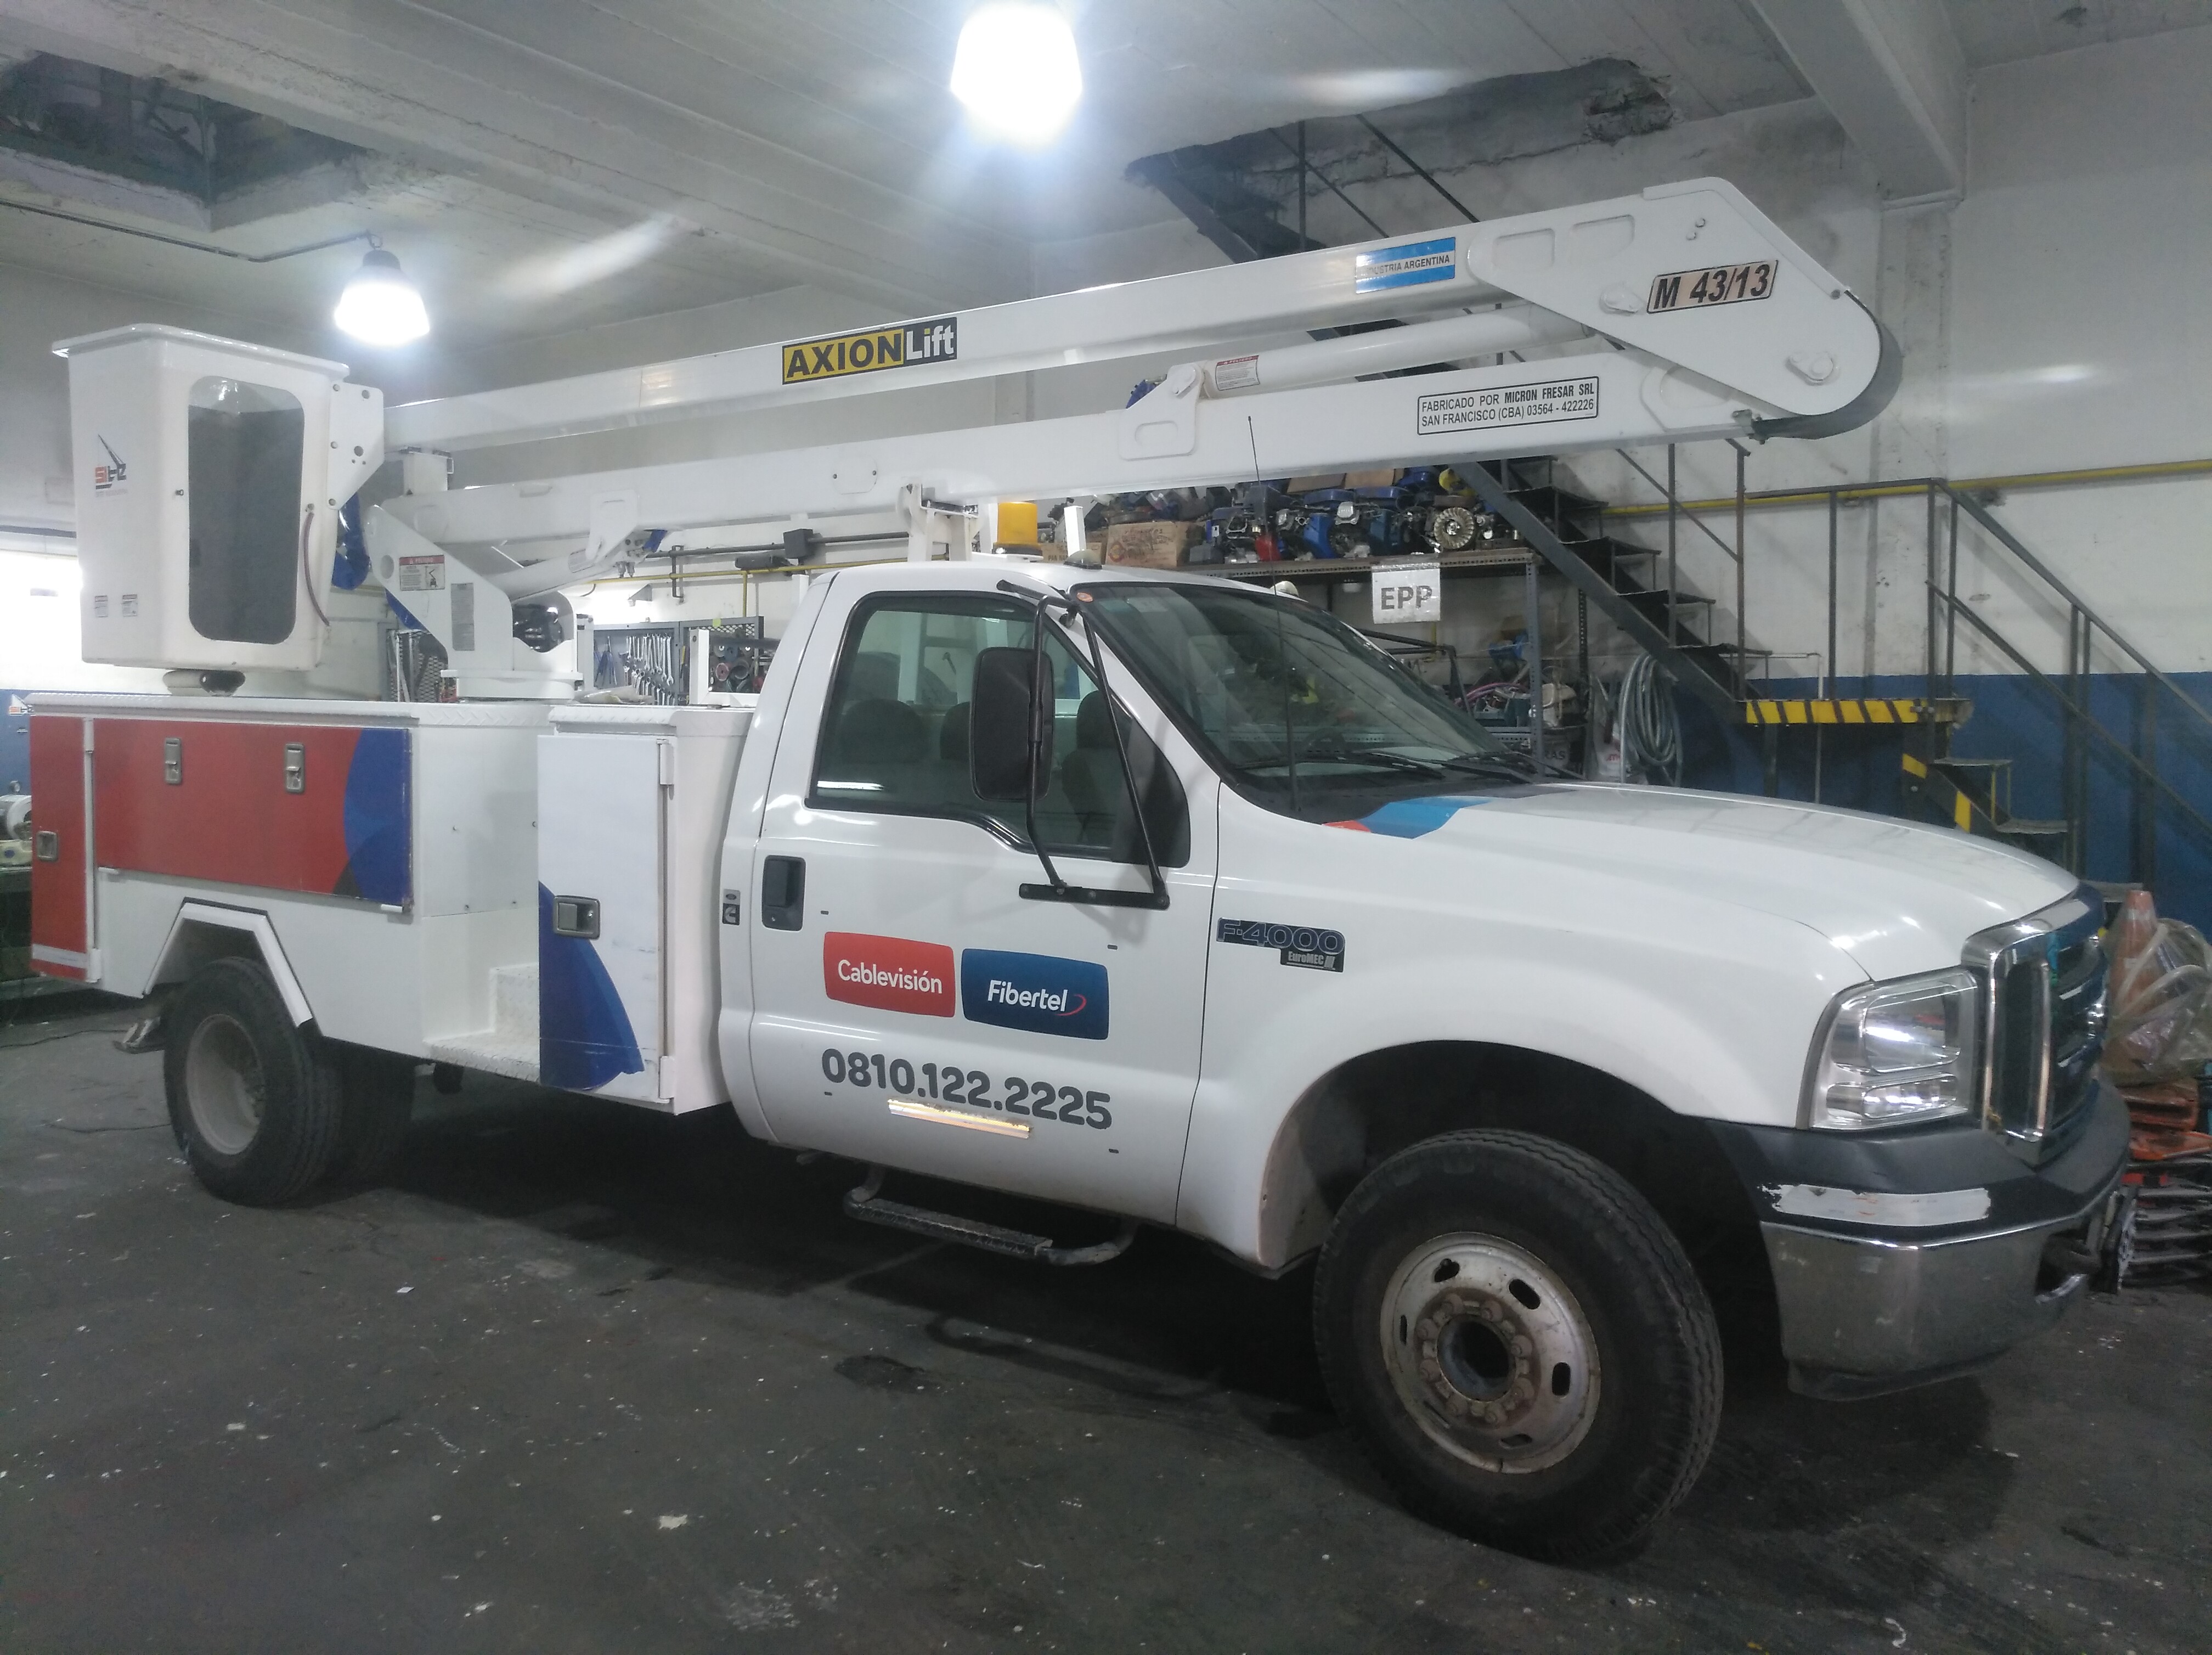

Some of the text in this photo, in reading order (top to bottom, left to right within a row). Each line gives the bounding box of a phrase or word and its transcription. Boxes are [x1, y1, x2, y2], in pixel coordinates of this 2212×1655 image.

[1404, 255, 1449, 269] ARGENTINA
[1654, 264, 1770, 309] M 43/13
[1422, 383, 1594, 412] FABRICADO POR MICRON FRESAR SRL
[1422, 415, 1440, 426] SAN
[1443, 409, 1496, 424] FRANCISCO
[1498, 406, 1524, 421] (CBA)
[1527, 403, 1553, 416] 03564
[1561, 399, 1594, 412] 422226
[1381, 586, 1432, 610] EPP
[1217, 918, 1345, 955] F-4000
[1289, 951, 1324, 965] EuroMEC
[838, 959, 943, 994] Cablevisión
[988, 980, 1069, 1012] Fibertel
[822, 1048, 1112, 1129] 0810.122.2225
